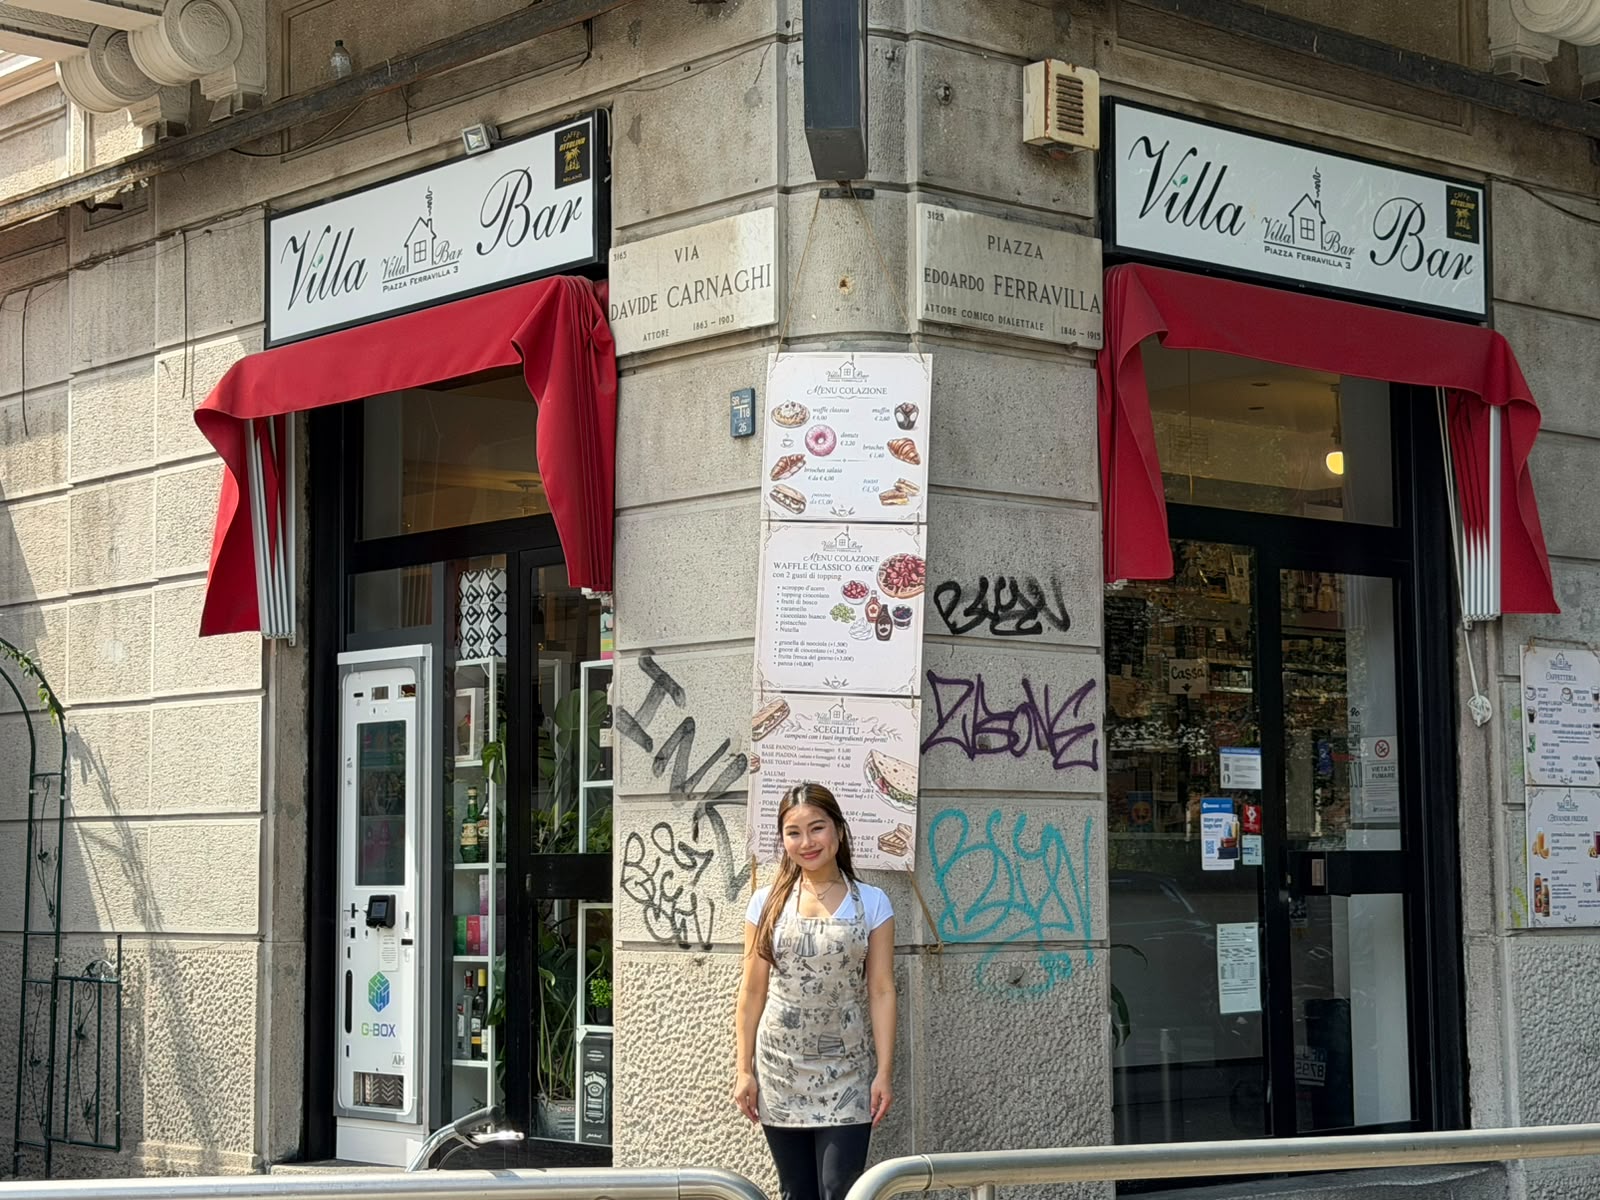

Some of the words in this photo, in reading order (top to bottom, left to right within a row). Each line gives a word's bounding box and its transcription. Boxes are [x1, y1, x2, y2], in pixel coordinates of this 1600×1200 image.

[1128, 135, 1246, 236] Villa
[476, 166, 582, 256] Bar
[927, 211, 944, 222] 3125
[1261, 217, 1291, 243] Villa
[1324, 230, 1355, 256] Bar
[1369, 196, 1474, 280] Bar
[674, 245, 699, 263] VIA
[987, 234, 1044, 260] PIAZZA
[281, 225, 368, 311] Villa
[381, 256, 405, 280] Villa
[434, 241, 463, 265] Bar
[453, 265, 459, 274] 3
[610, 293, 658, 322] DAVIDE
[667, 264, 771, 308] CARNAGHI
[924, 267, 984, 292] EDOARDO
[994, 274, 1101, 314] FERRAVILLA
[693, 320, 708, 331] 1863
[718, 314, 735, 325] 1903
[925, 303, 957, 316] ATTORE
[961, 309, 994, 322] COMICO
[998, 316, 1044, 331] DIALETTALE
[642, 328, 670, 342] ATTORE
[1061, 326, 1076, 337] 1846
[839, 387, 888, 395] COLAZIONE
[773, 562, 808, 570] WAFFLE
[810, 563, 852, 572] CLASSICO
[834, 555, 880, 563] COLAZIONE
[792, 572, 807, 580] gusti
[817, 573, 842, 581] topping
[1171, 666, 1204, 680] Cassa
[813, 725, 844, 734] SCEGLI
[847, 727, 860, 735] TU
[361, 1023, 396, 1038] G-BOX
